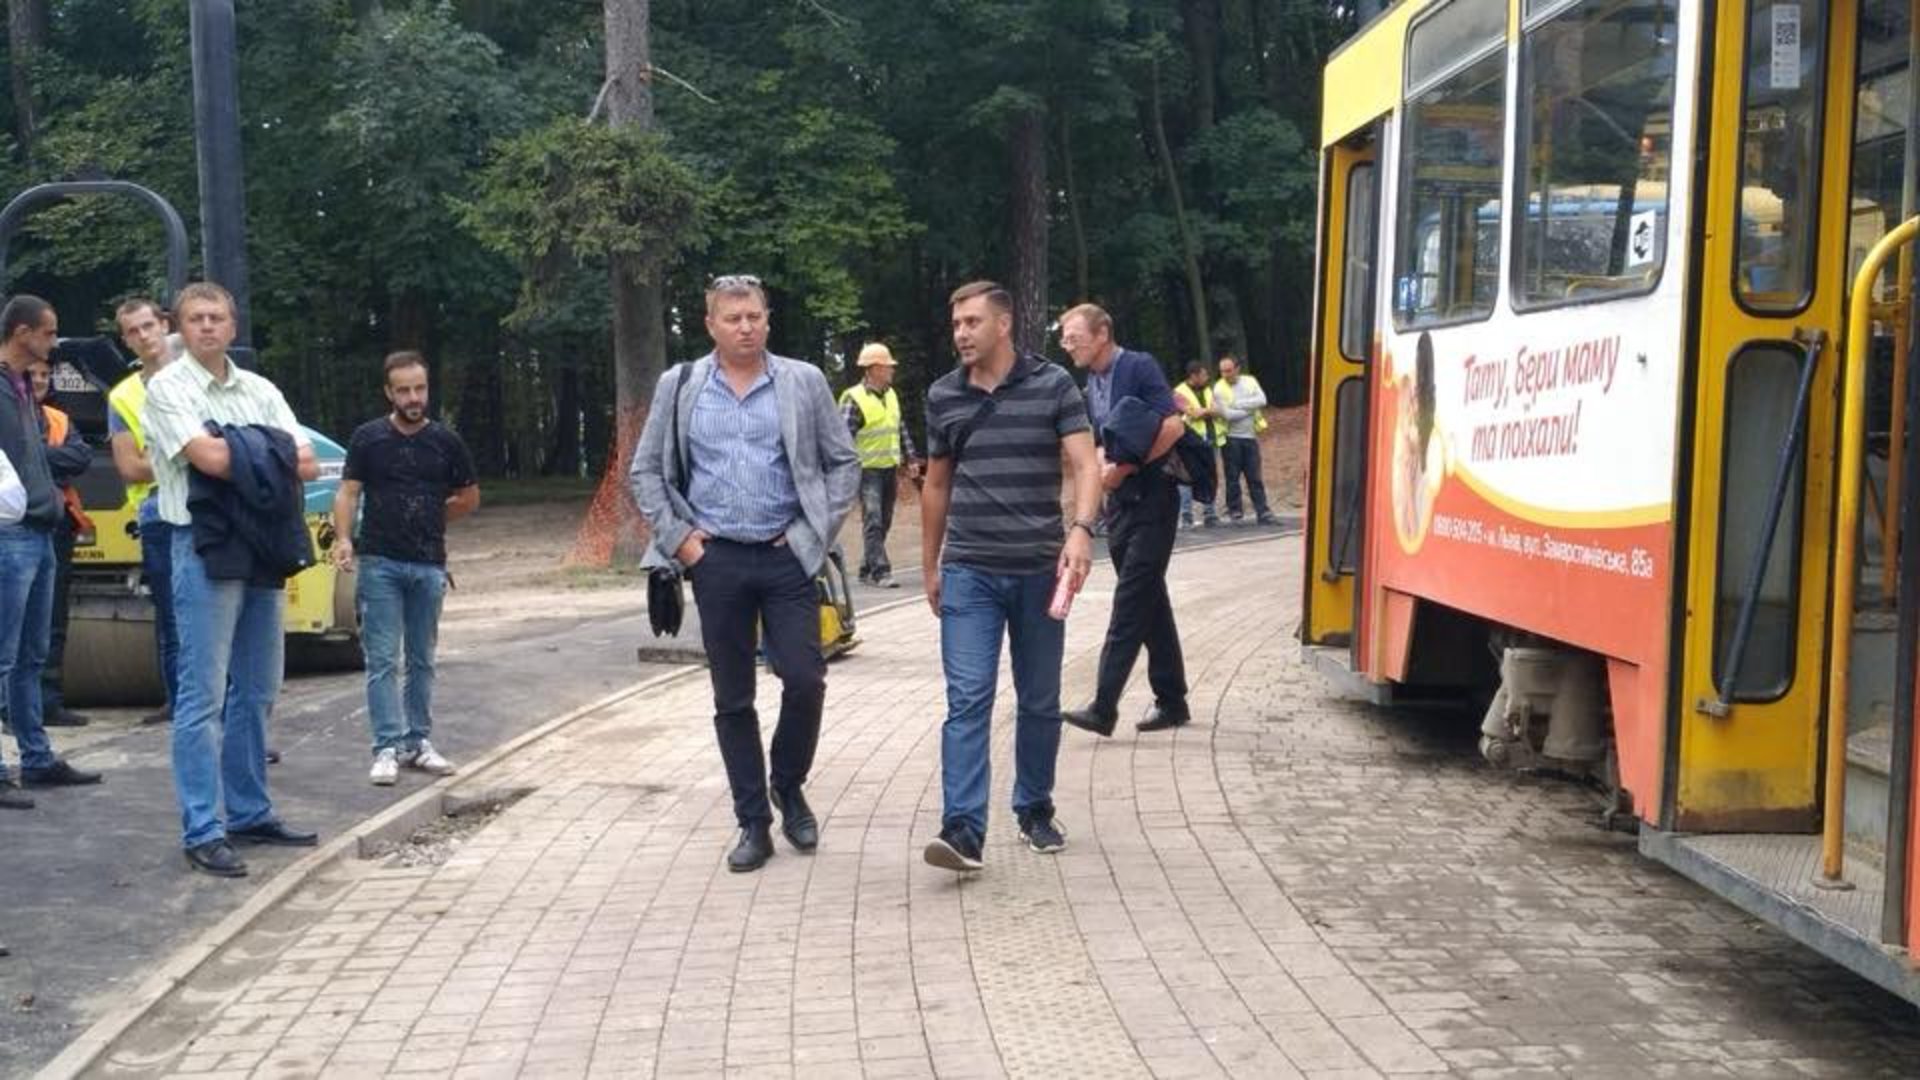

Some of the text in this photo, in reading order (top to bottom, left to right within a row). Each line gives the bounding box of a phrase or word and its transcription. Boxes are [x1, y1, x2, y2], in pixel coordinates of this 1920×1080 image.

[1463, 334, 1621, 410] Тату, бери маму
[1471, 398, 1583, 463] та поїхали!
[1631, 547, 1654, 579] 85а
